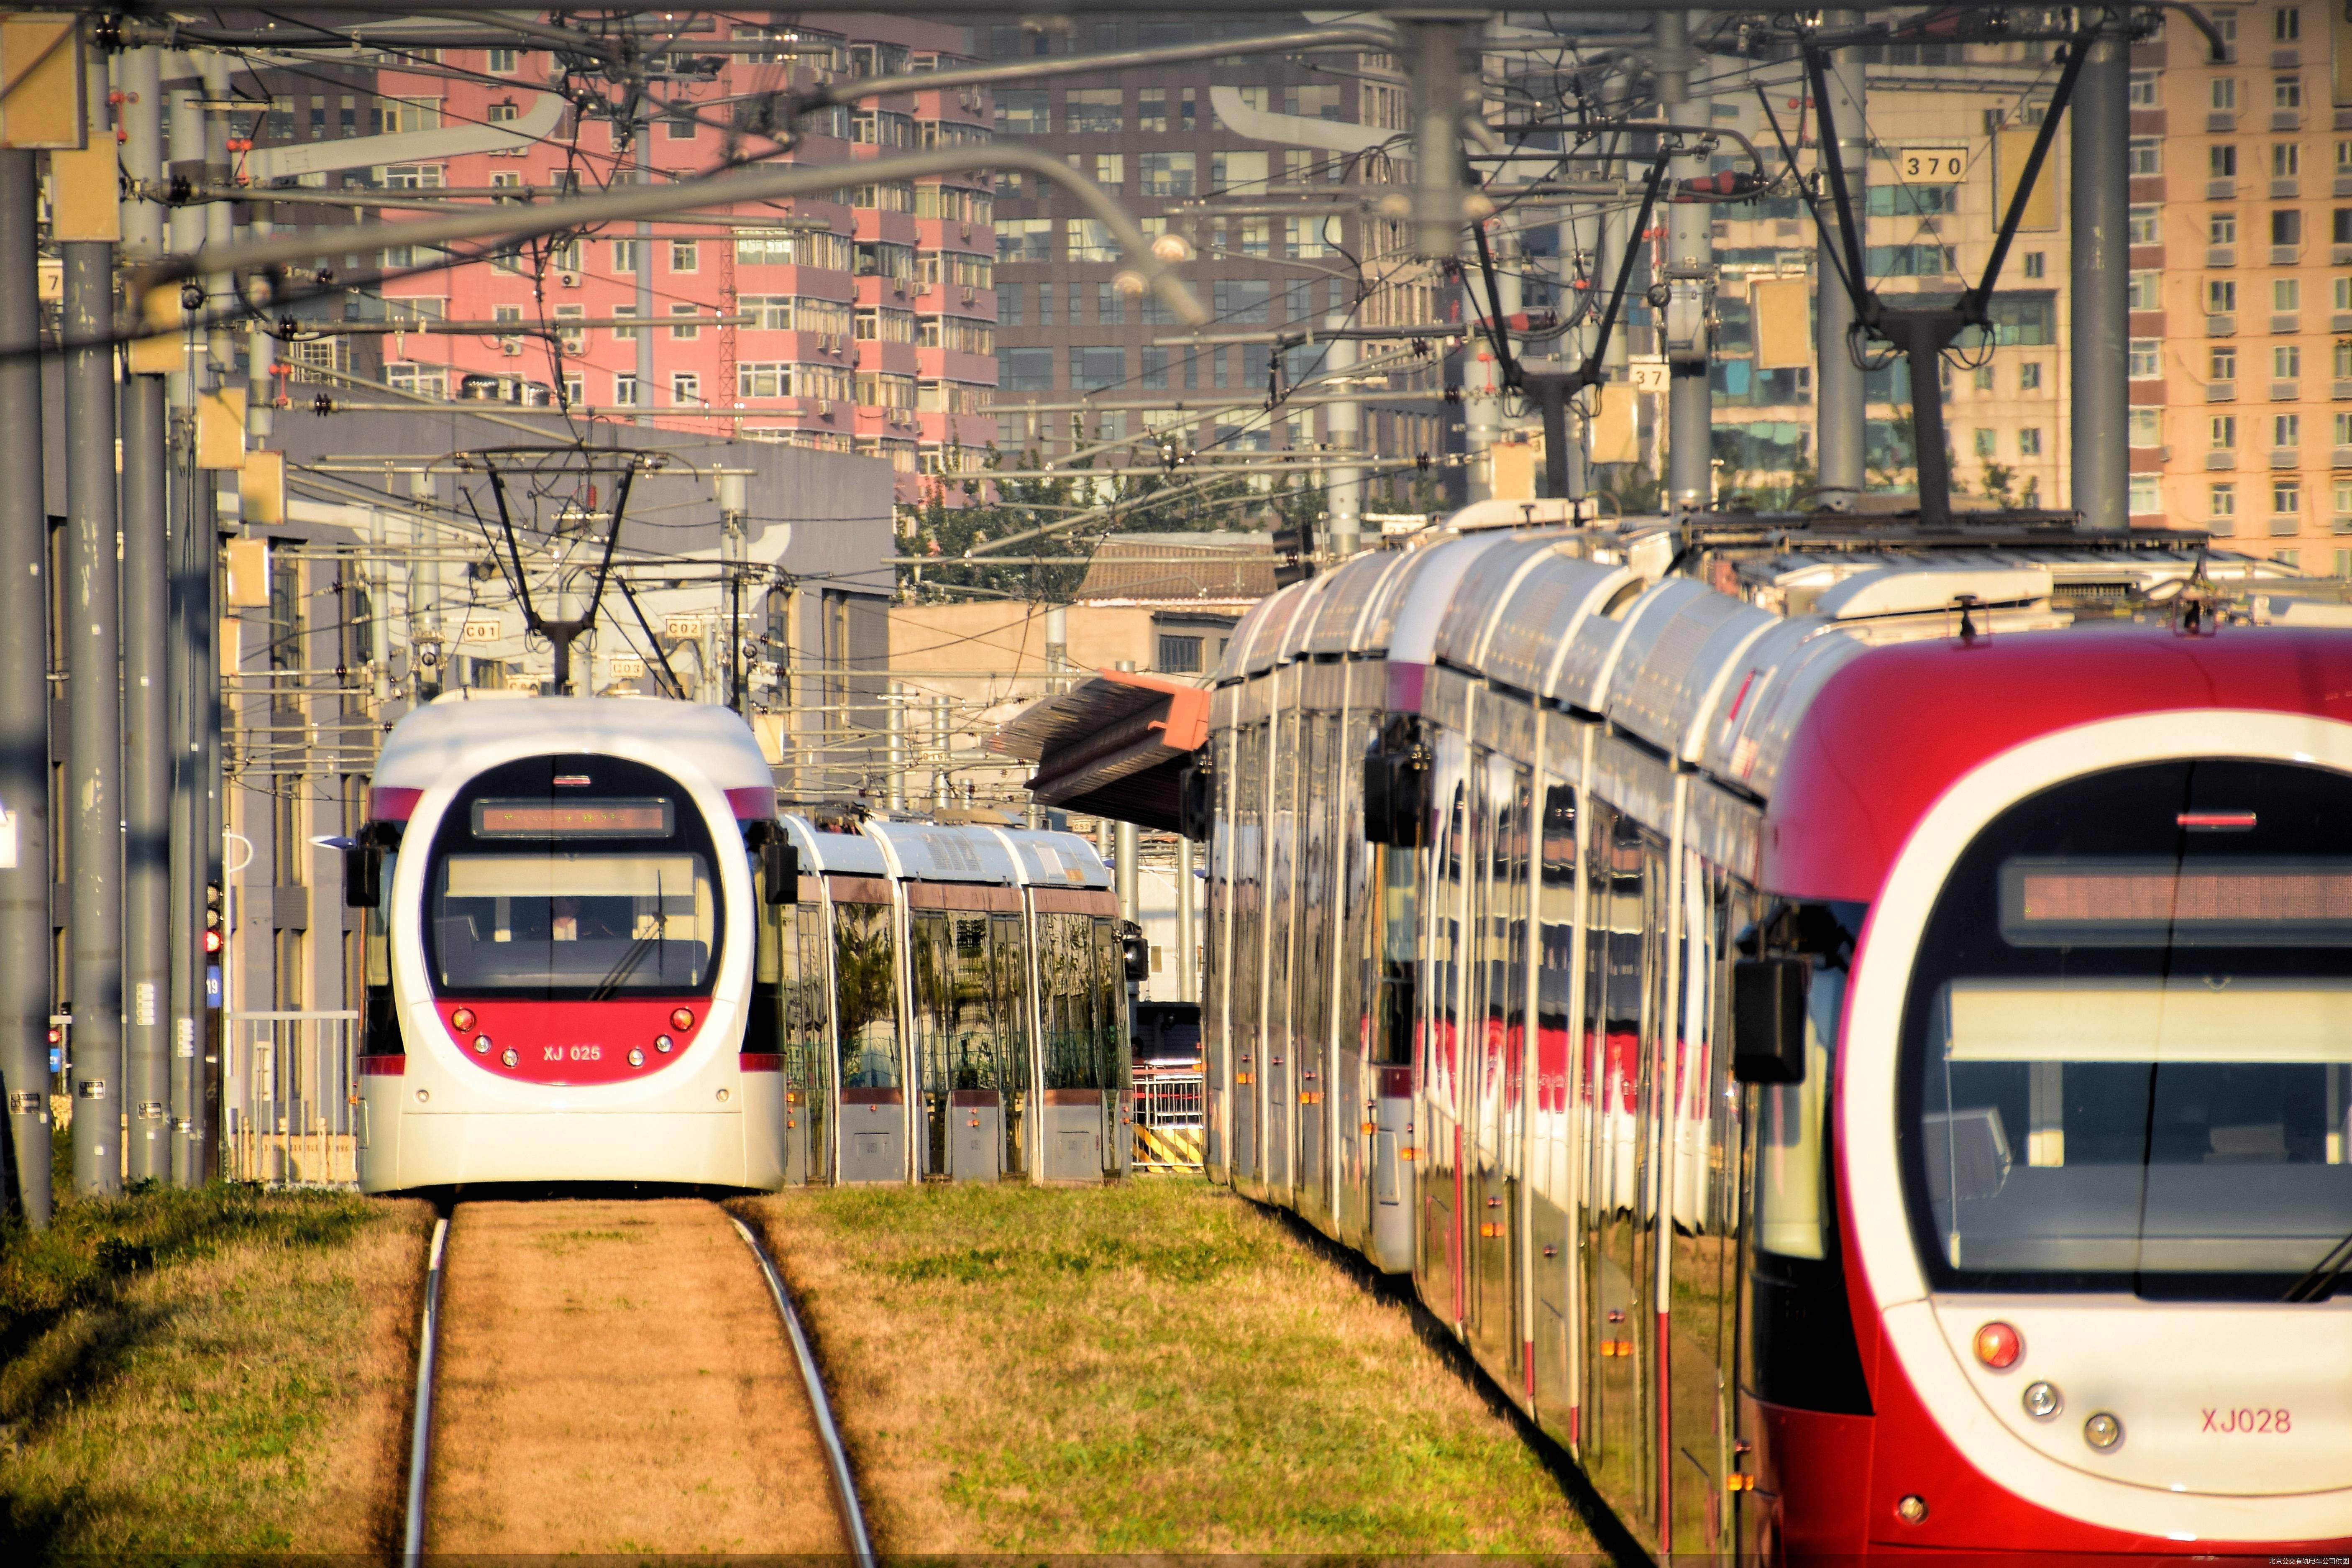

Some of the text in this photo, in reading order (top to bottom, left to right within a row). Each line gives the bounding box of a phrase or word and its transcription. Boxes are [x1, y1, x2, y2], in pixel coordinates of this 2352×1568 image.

[1908, 157, 1960, 175] 370
[466, 626, 494, 637] C01
[669, 624, 698, 634] C02
[543, 1045, 601, 1061] XJ 025
[2201, 1408, 2291, 1433] XJ028
